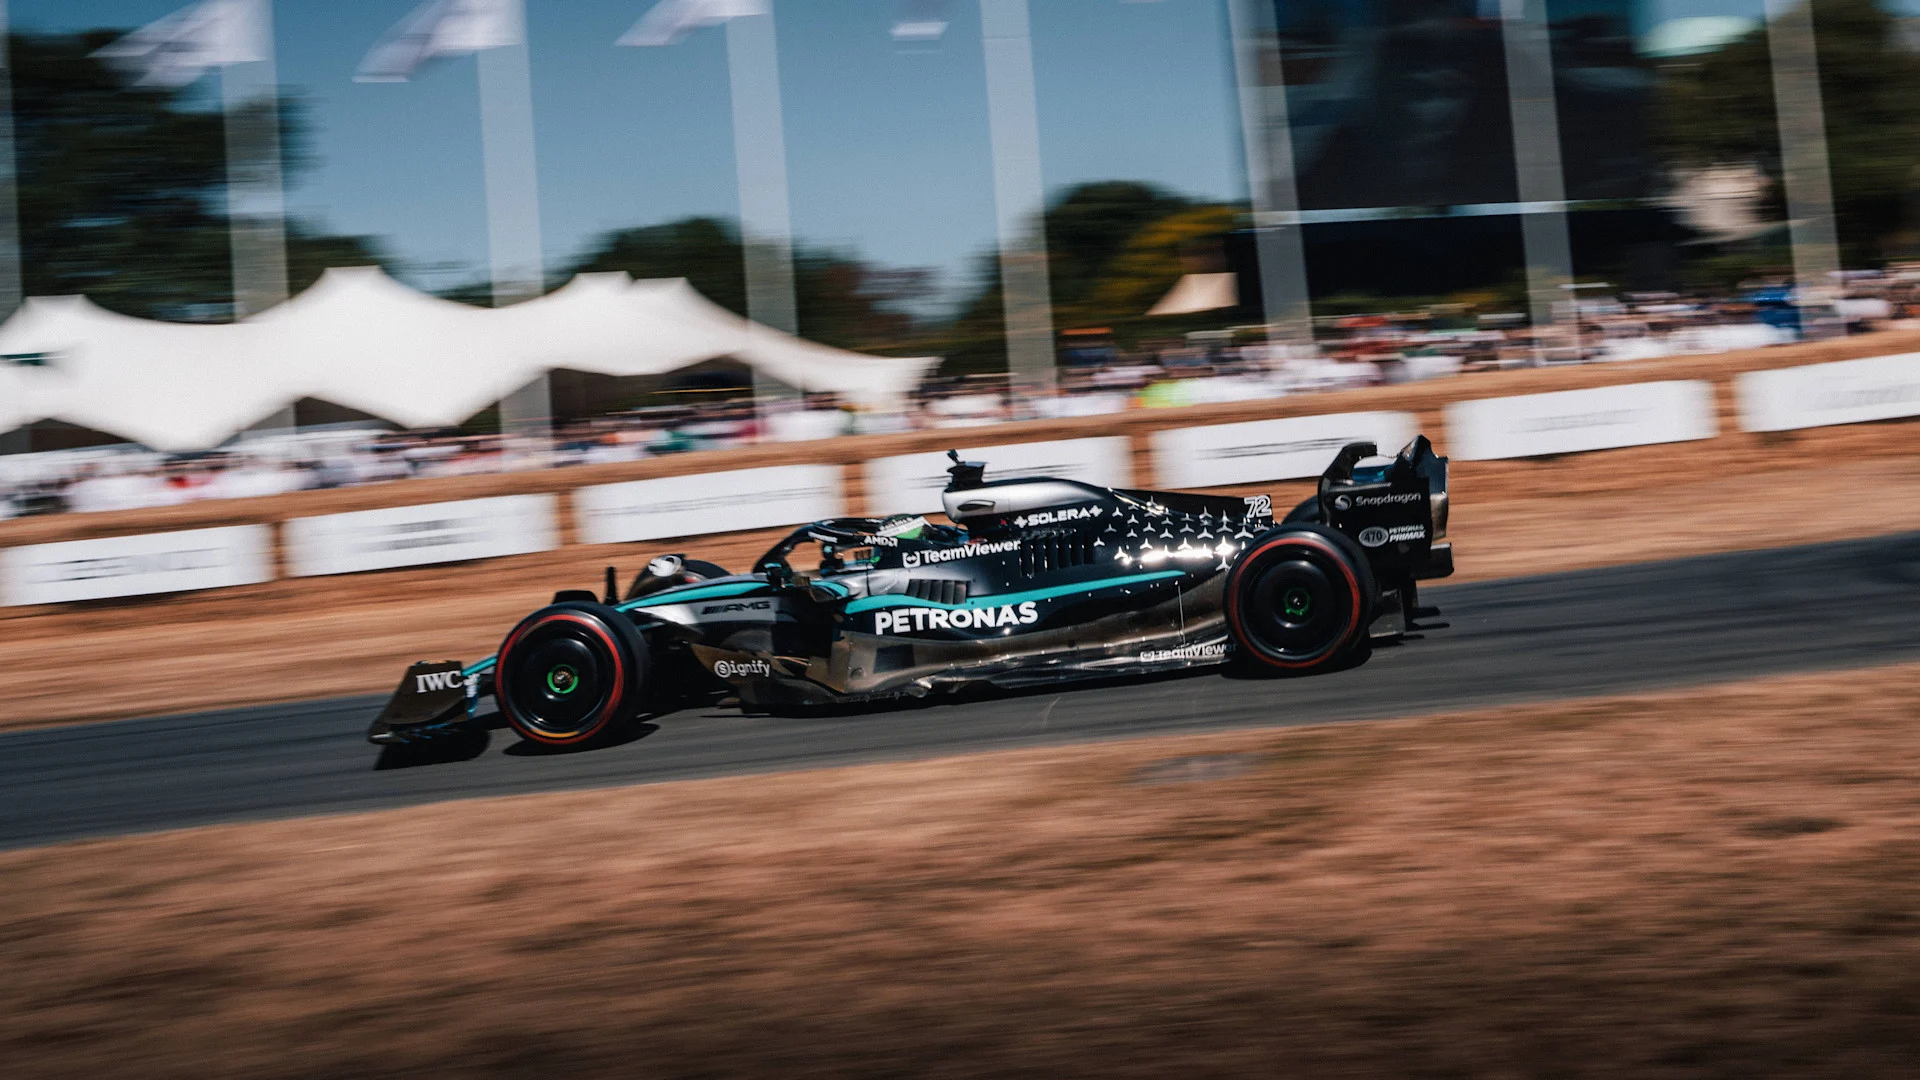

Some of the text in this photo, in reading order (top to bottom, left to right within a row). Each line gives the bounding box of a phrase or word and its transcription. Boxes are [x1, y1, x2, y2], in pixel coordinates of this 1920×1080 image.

[1243, 494, 1272, 519] 72
[1355, 492, 1421, 506] Snapdragon
[1027, 507, 1092, 526] SOLERA
[864, 536, 889, 547] AMD
[920, 538, 1022, 564] TeamViewer
[725, 601, 771, 613] AMG
[874, 601, 1039, 636] PETRONAS
[415, 670, 463, 693] IWC
